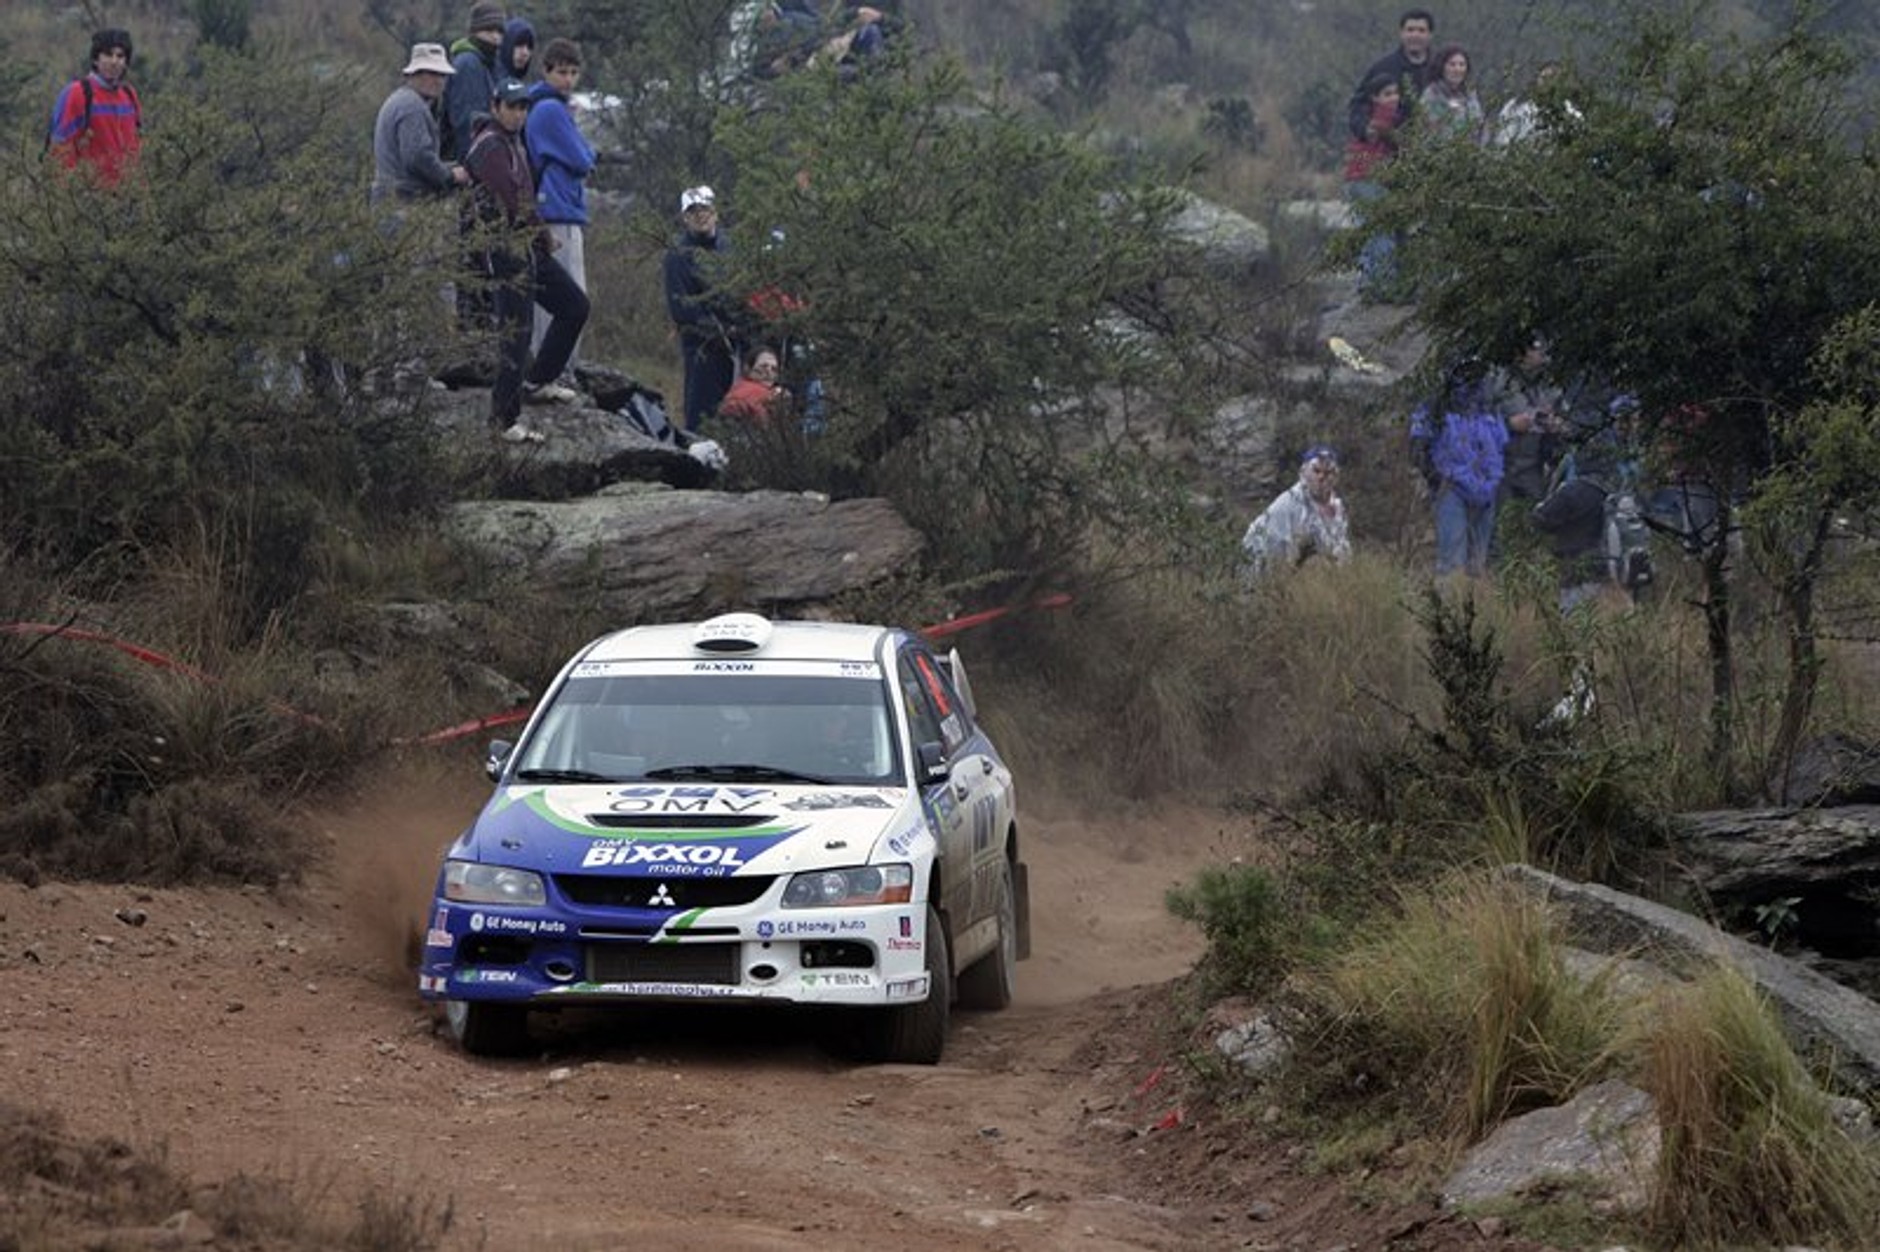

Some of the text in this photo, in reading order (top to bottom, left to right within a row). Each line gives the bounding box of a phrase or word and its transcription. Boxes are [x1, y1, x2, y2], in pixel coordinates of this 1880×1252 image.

[609, 798, 763, 812] OMV
[592, 838, 638, 848] OMV
[648, 864, 725, 876] motor oil
[486, 916, 566, 933] GE Money Auto
[778, 920, 866, 933] GE Money Auto
[479, 970, 517, 981] TEIN
[820, 974, 871, 985] TEIN
